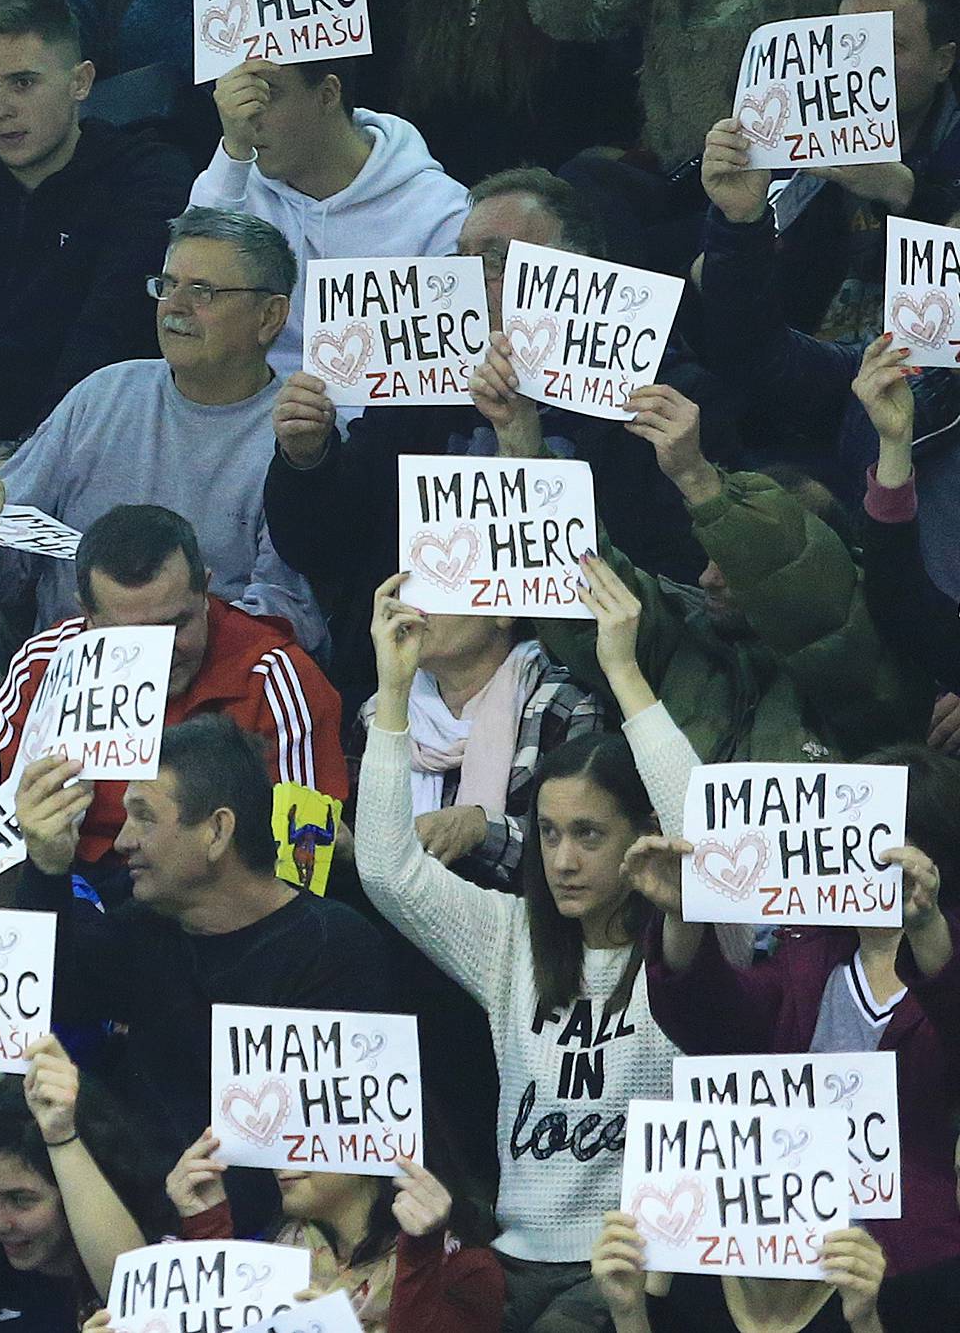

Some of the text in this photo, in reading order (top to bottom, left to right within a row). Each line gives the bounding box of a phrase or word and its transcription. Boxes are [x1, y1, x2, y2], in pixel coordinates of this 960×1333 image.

[243, 13, 364, 62] ZA MAŠU
[745, 24, 834, 87] IMAM
[797, 65, 891, 126] HERC
[784, 116, 896, 160] ZA MAŠU
[316, 265, 421, 323] IMAM
[515, 261, 617, 315] IMAM
[378, 309, 486, 363] HERC
[563, 318, 658, 372] HERC
[367, 370, 409, 399] ZA
[542, 369, 576, 399] ZA
[417, 468, 528, 522] IMAM
[488, 518, 585, 571] HERC
[471, 578, 512, 607] ZA
[36, 637, 105, 711] IMAM
[57, 682, 155, 736] HERC
[82, 734, 156, 768] MAŠU
[705, 773, 827, 829] IMAM
[778, 822, 893, 879] HERC
[758, 879, 895, 916] ZA MAŠU
[229, 1022, 343, 1076] IMAM
[558, 1051, 606, 1099] IN
[299, 1072, 413, 1127] HERC
[690, 1064, 816, 1108] IMAM
[283, 1127, 417, 1165] ZA MAŠU
[644, 1116, 762, 1173] IMAM
[715, 1169, 838, 1228] HERC
[696, 1235, 745, 1266] ZA
[120, 1251, 226, 1318] IMAM
